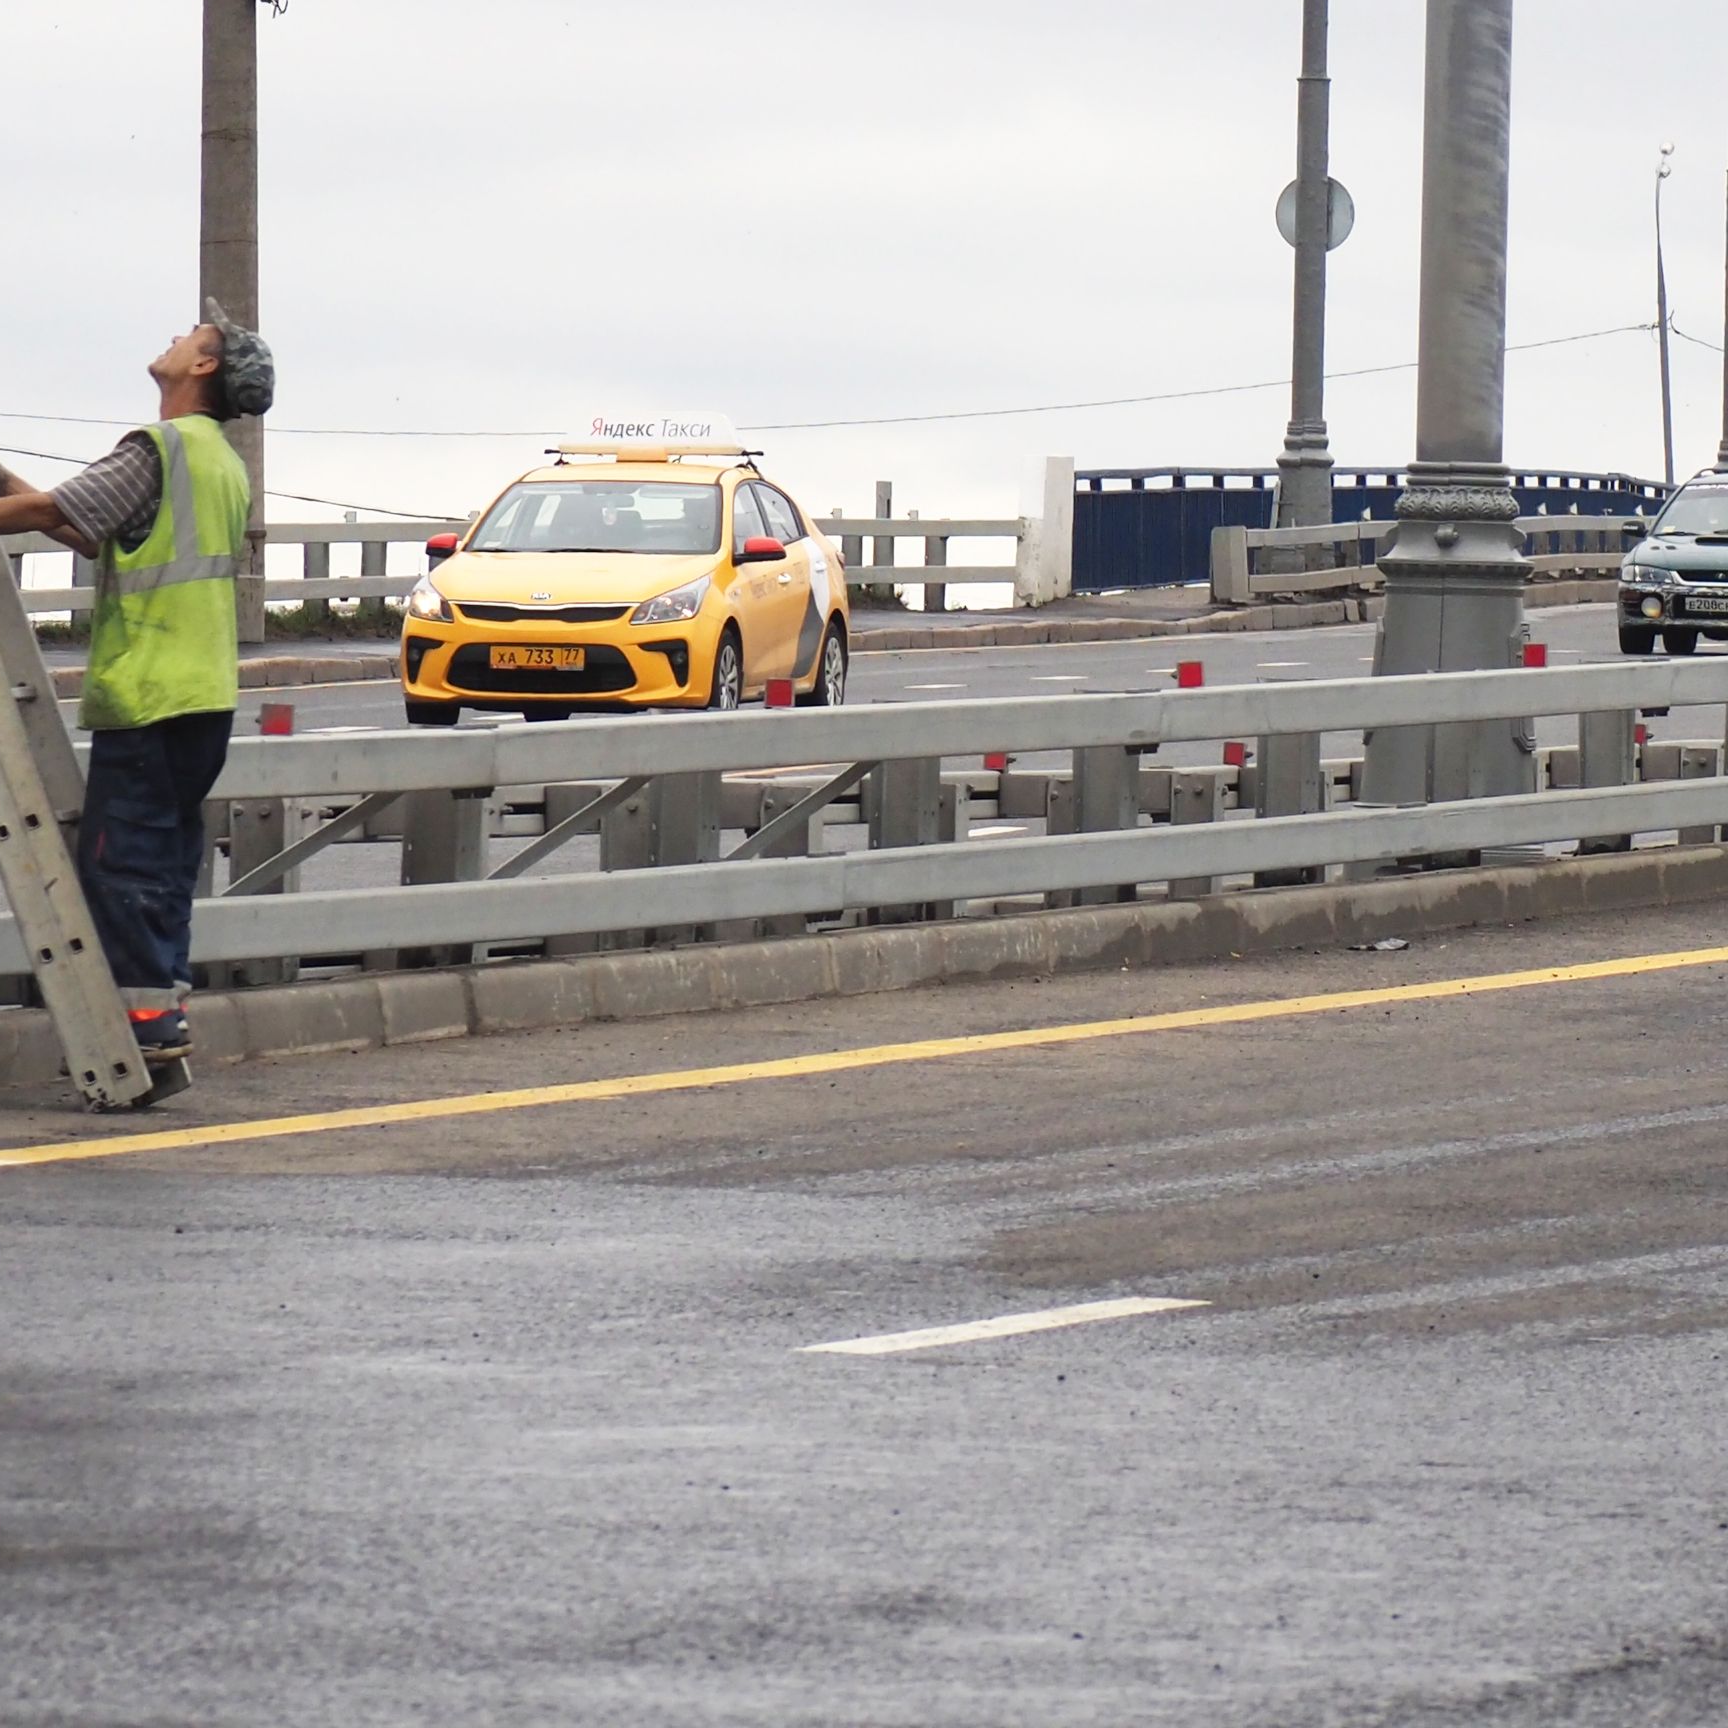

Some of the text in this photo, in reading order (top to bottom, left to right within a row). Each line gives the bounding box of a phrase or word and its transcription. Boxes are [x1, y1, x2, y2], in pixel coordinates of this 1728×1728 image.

[590, 417, 712, 439] Яндекс Такси
[525, 648, 554, 664] 733
[564, 648, 580, 661] 77
